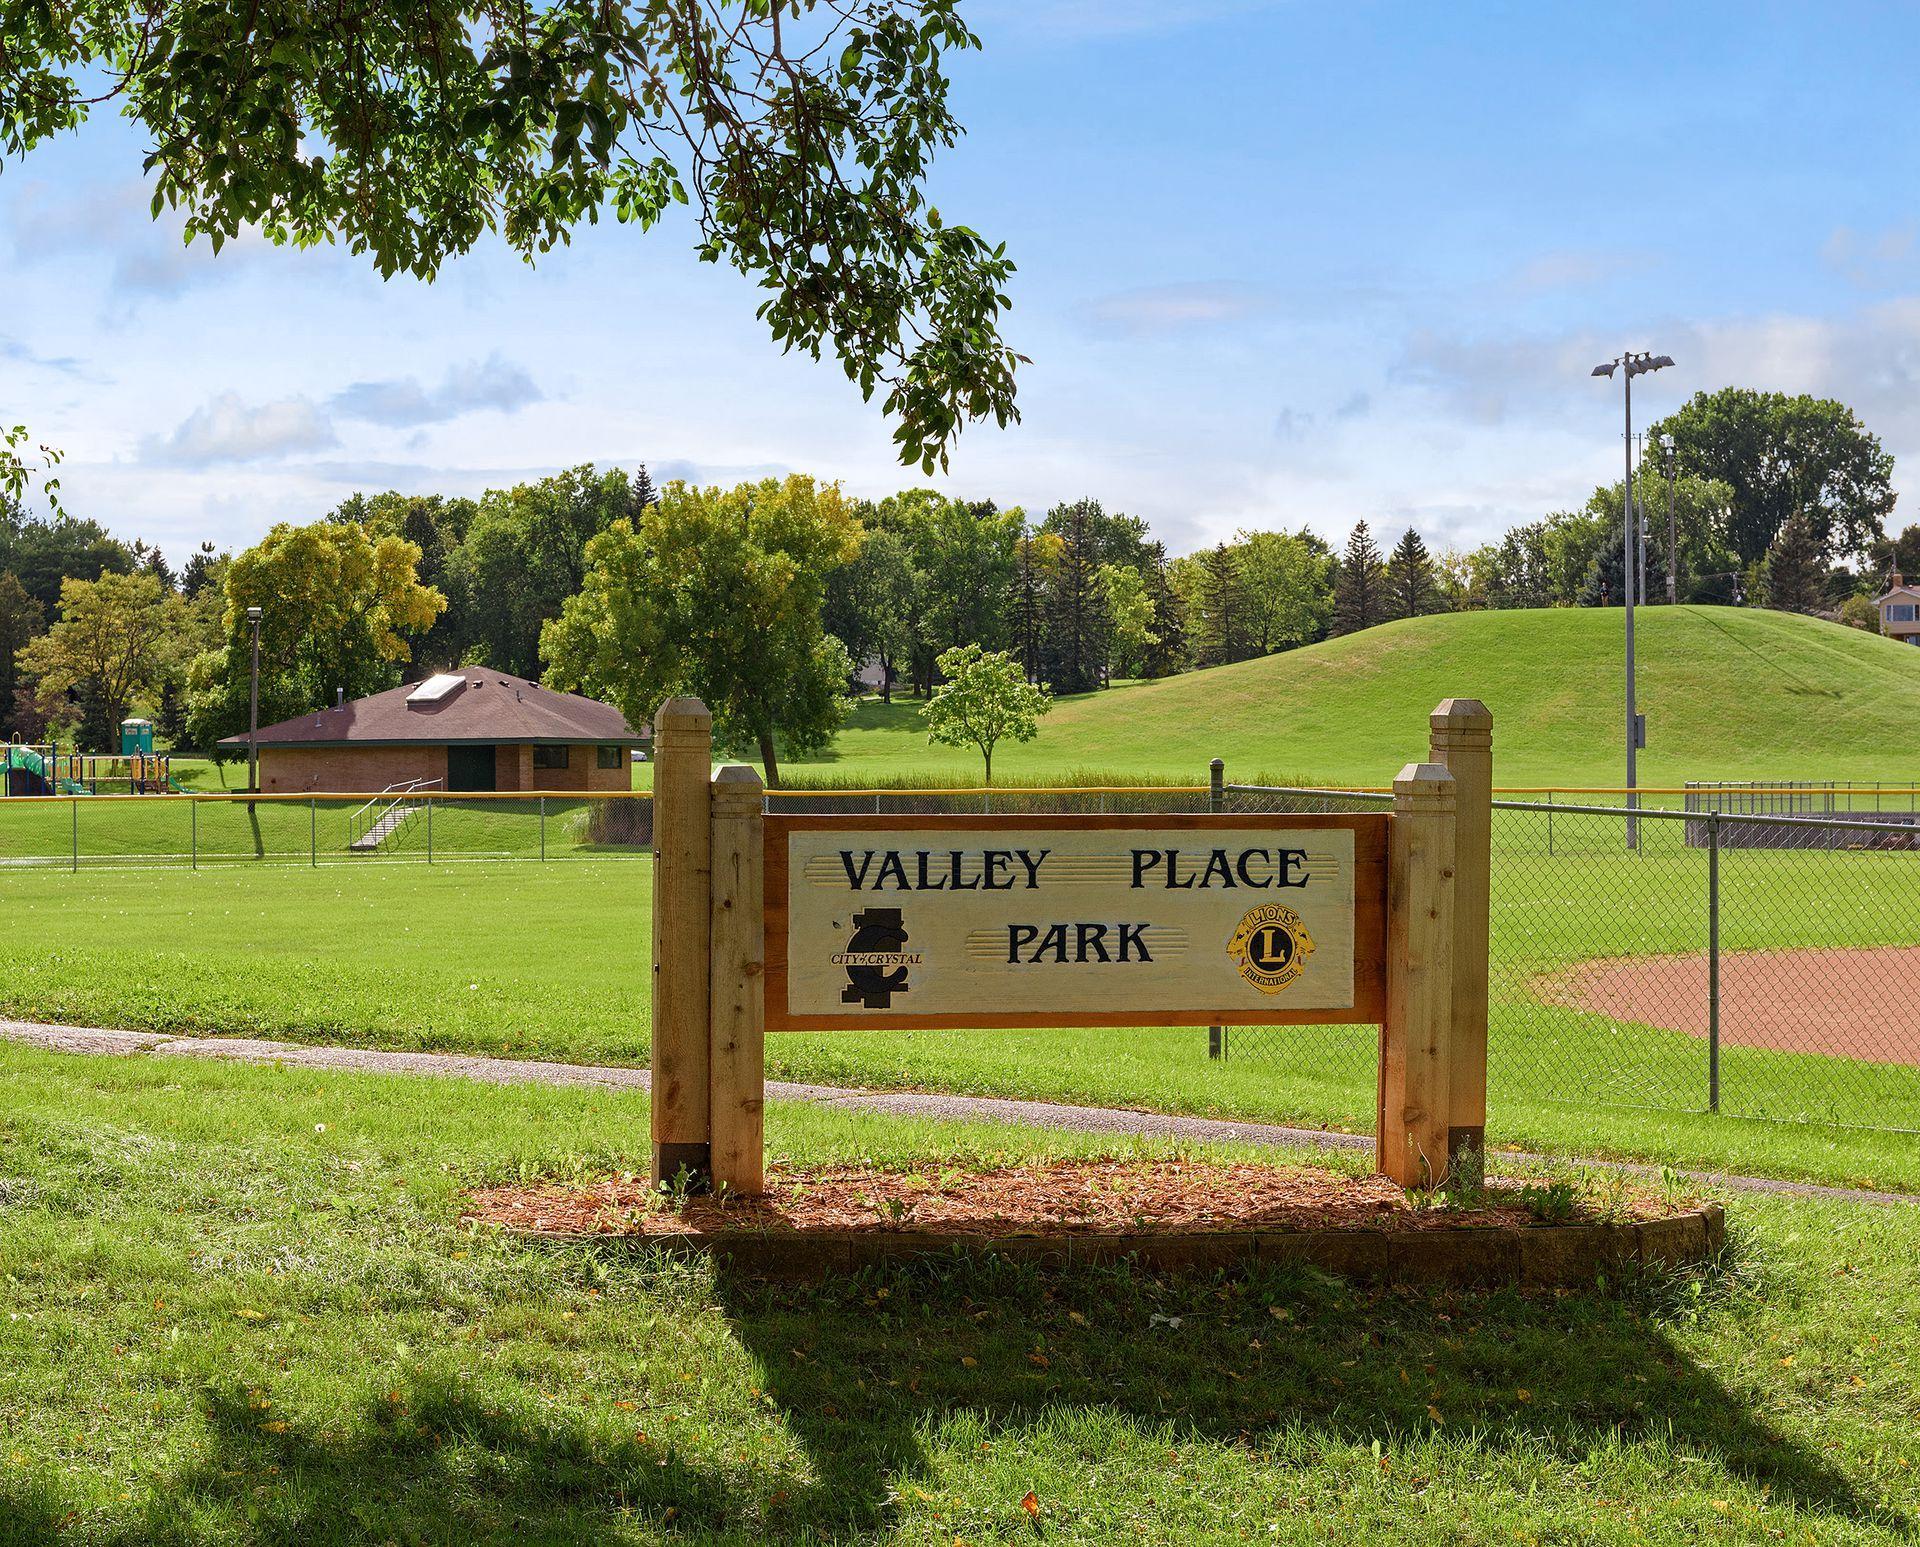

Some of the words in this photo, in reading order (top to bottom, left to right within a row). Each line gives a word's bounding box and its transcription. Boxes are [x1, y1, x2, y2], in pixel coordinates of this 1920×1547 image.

[840, 849, 1050, 890] VALLEY
[1130, 848, 1310, 889] PLACE
[1249, 906, 1296, 927] LIONS
[1006, 923, 1154, 964] PARK
[1260, 929, 1286, 963] L
[831, 954, 860, 965] CITY
[868, 953, 922, 964] CRYSTAL
[1244, 967, 1299, 986] INTERNATIONAL
